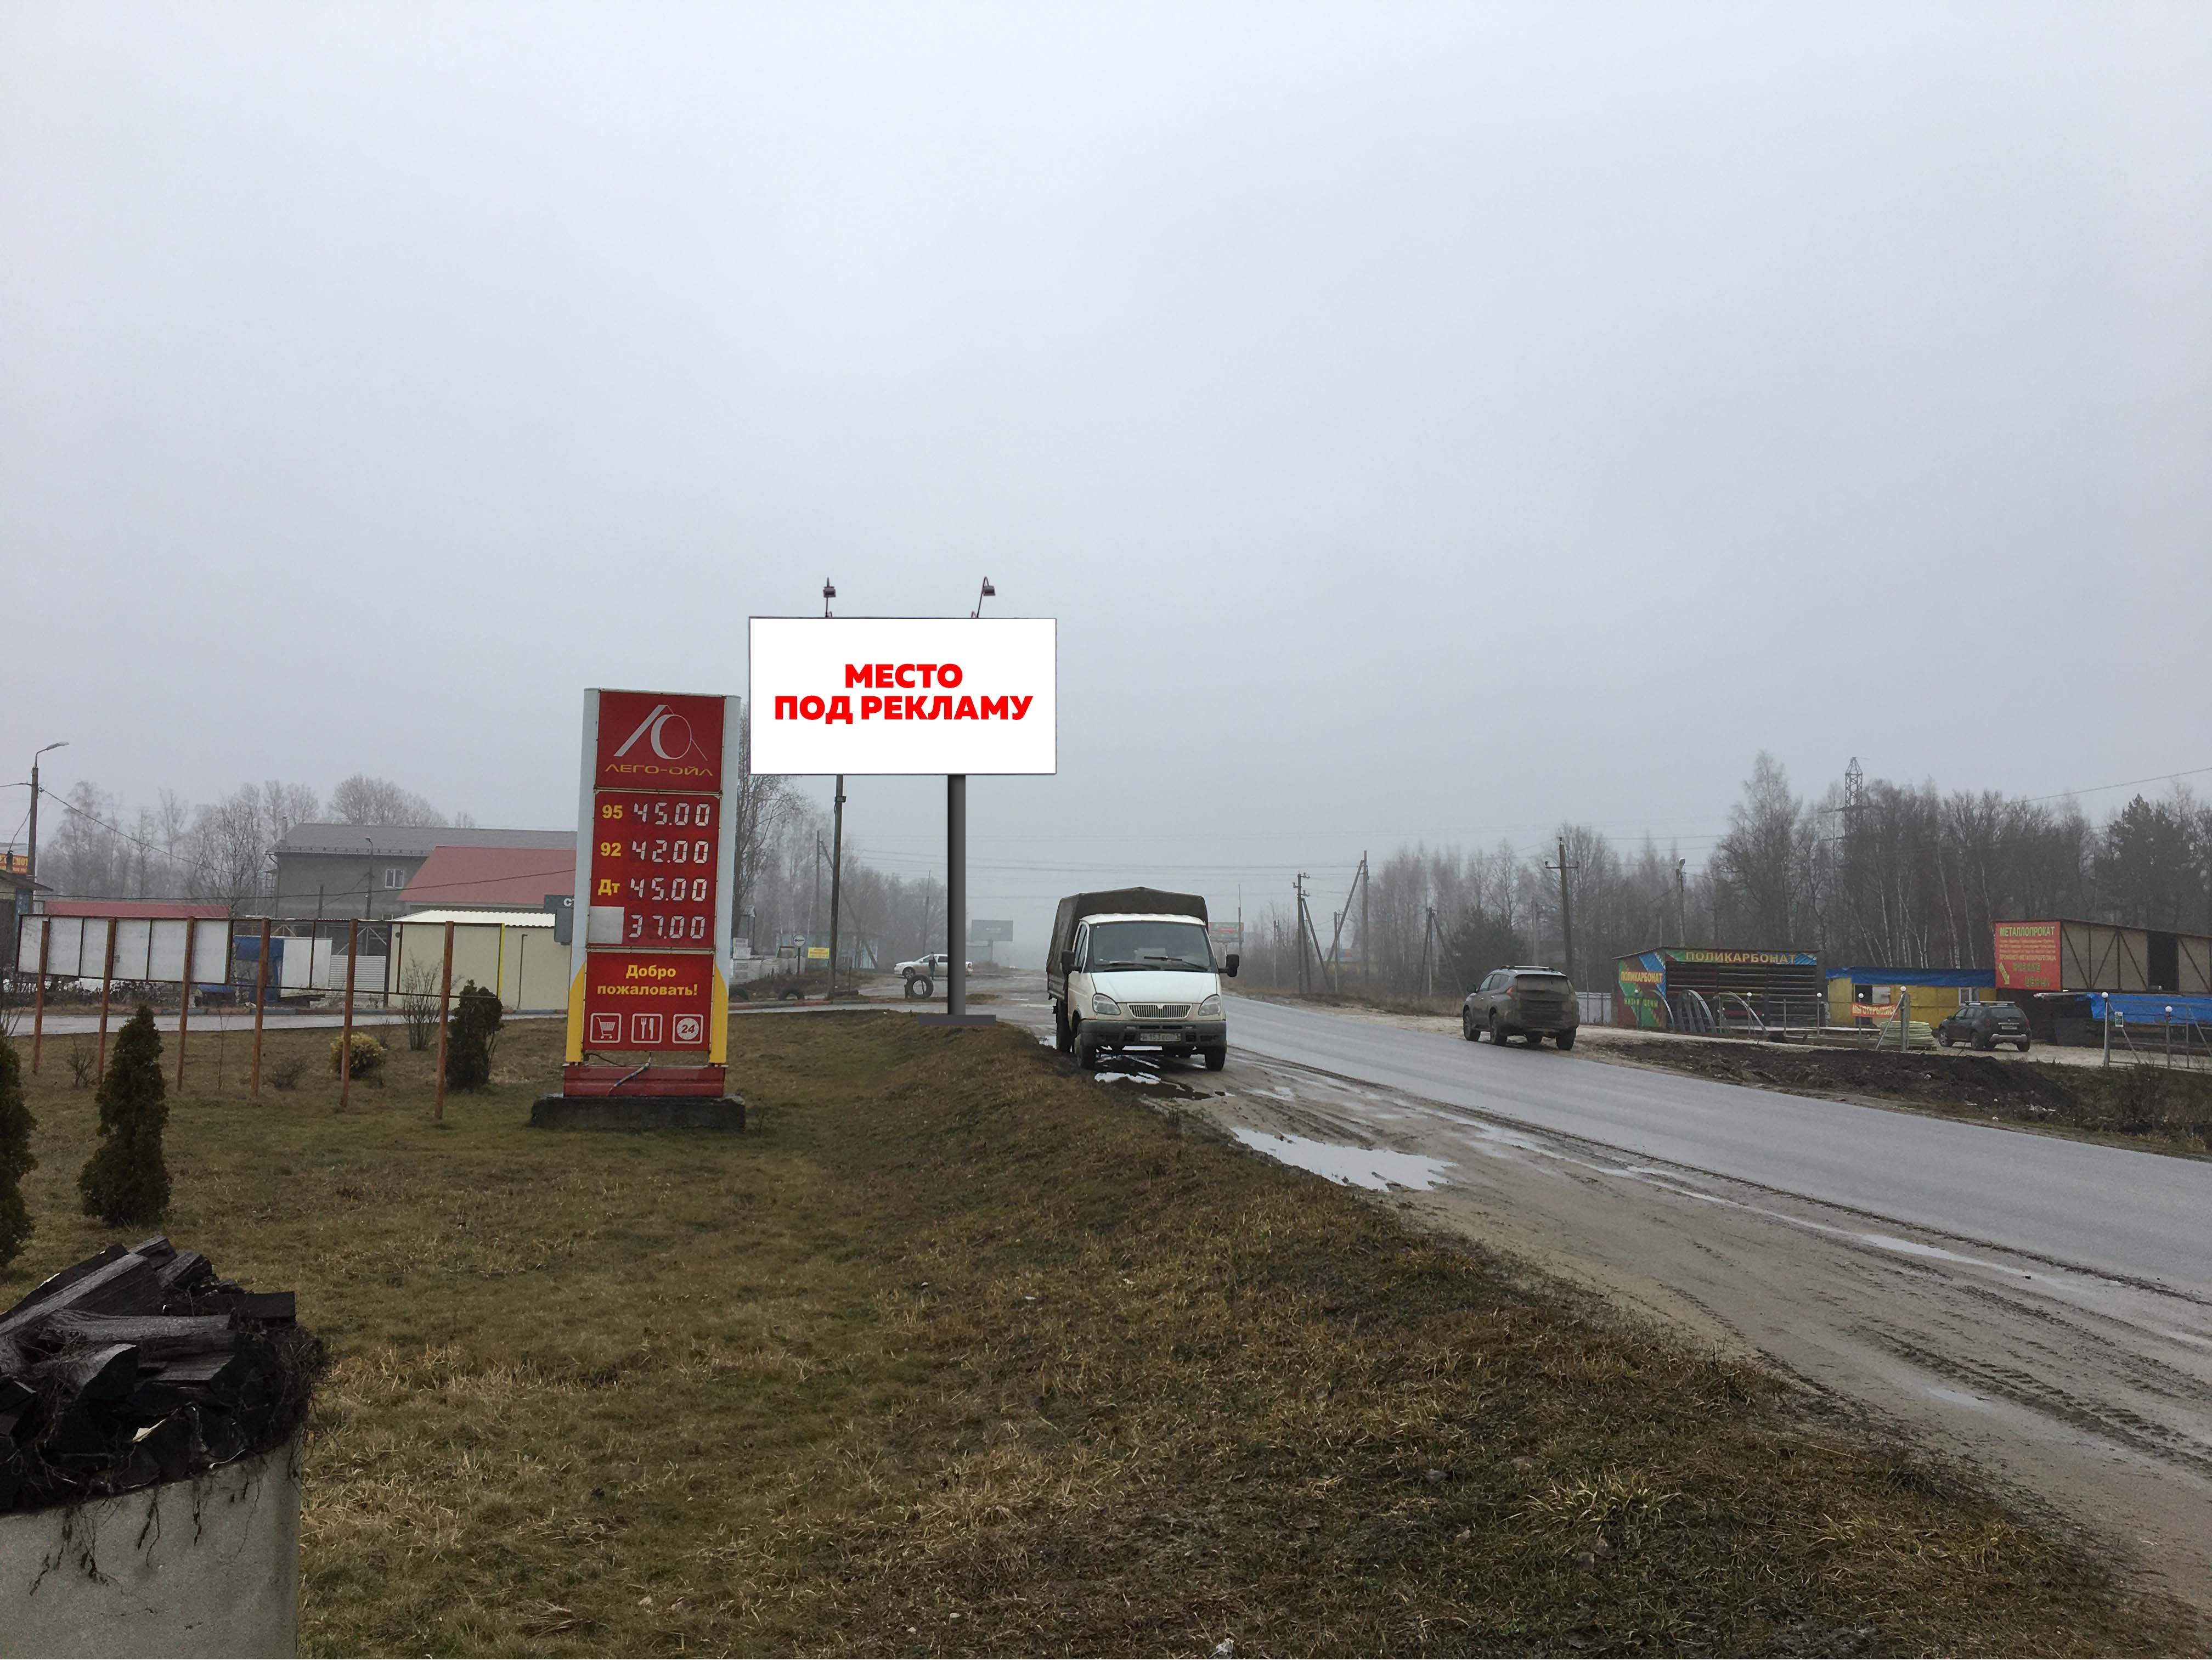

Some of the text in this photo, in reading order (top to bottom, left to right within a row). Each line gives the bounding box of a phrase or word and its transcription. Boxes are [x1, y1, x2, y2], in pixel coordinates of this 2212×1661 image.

[845, 663, 963, 688] МЕСТО
[775, 696, 1034, 724] ПОД РЕКЛАМУ
[605, 764, 713, 776] ЛЕГО-ОЙЛ
[602, 802, 710, 826] 95 45.00
[601, 840, 709, 864] 92 42.00
[597, 877, 707, 902] Дт 45.00
[563, 898, 574, 906] С
[629, 915, 706, 939] 37.00
[2000, 926, 2055, 937] МЕТАЛЛОПРОКАТ
[1685, 951, 1796, 964] ПОЛИКАРБОНАТ
[625, 965, 676, 980] Добро
[1621, 971, 1663, 984] ПОЛИКАРБОНАТ
[597, 984, 698, 996] пожаловать!
[681, 1024, 695, 1033] 24
